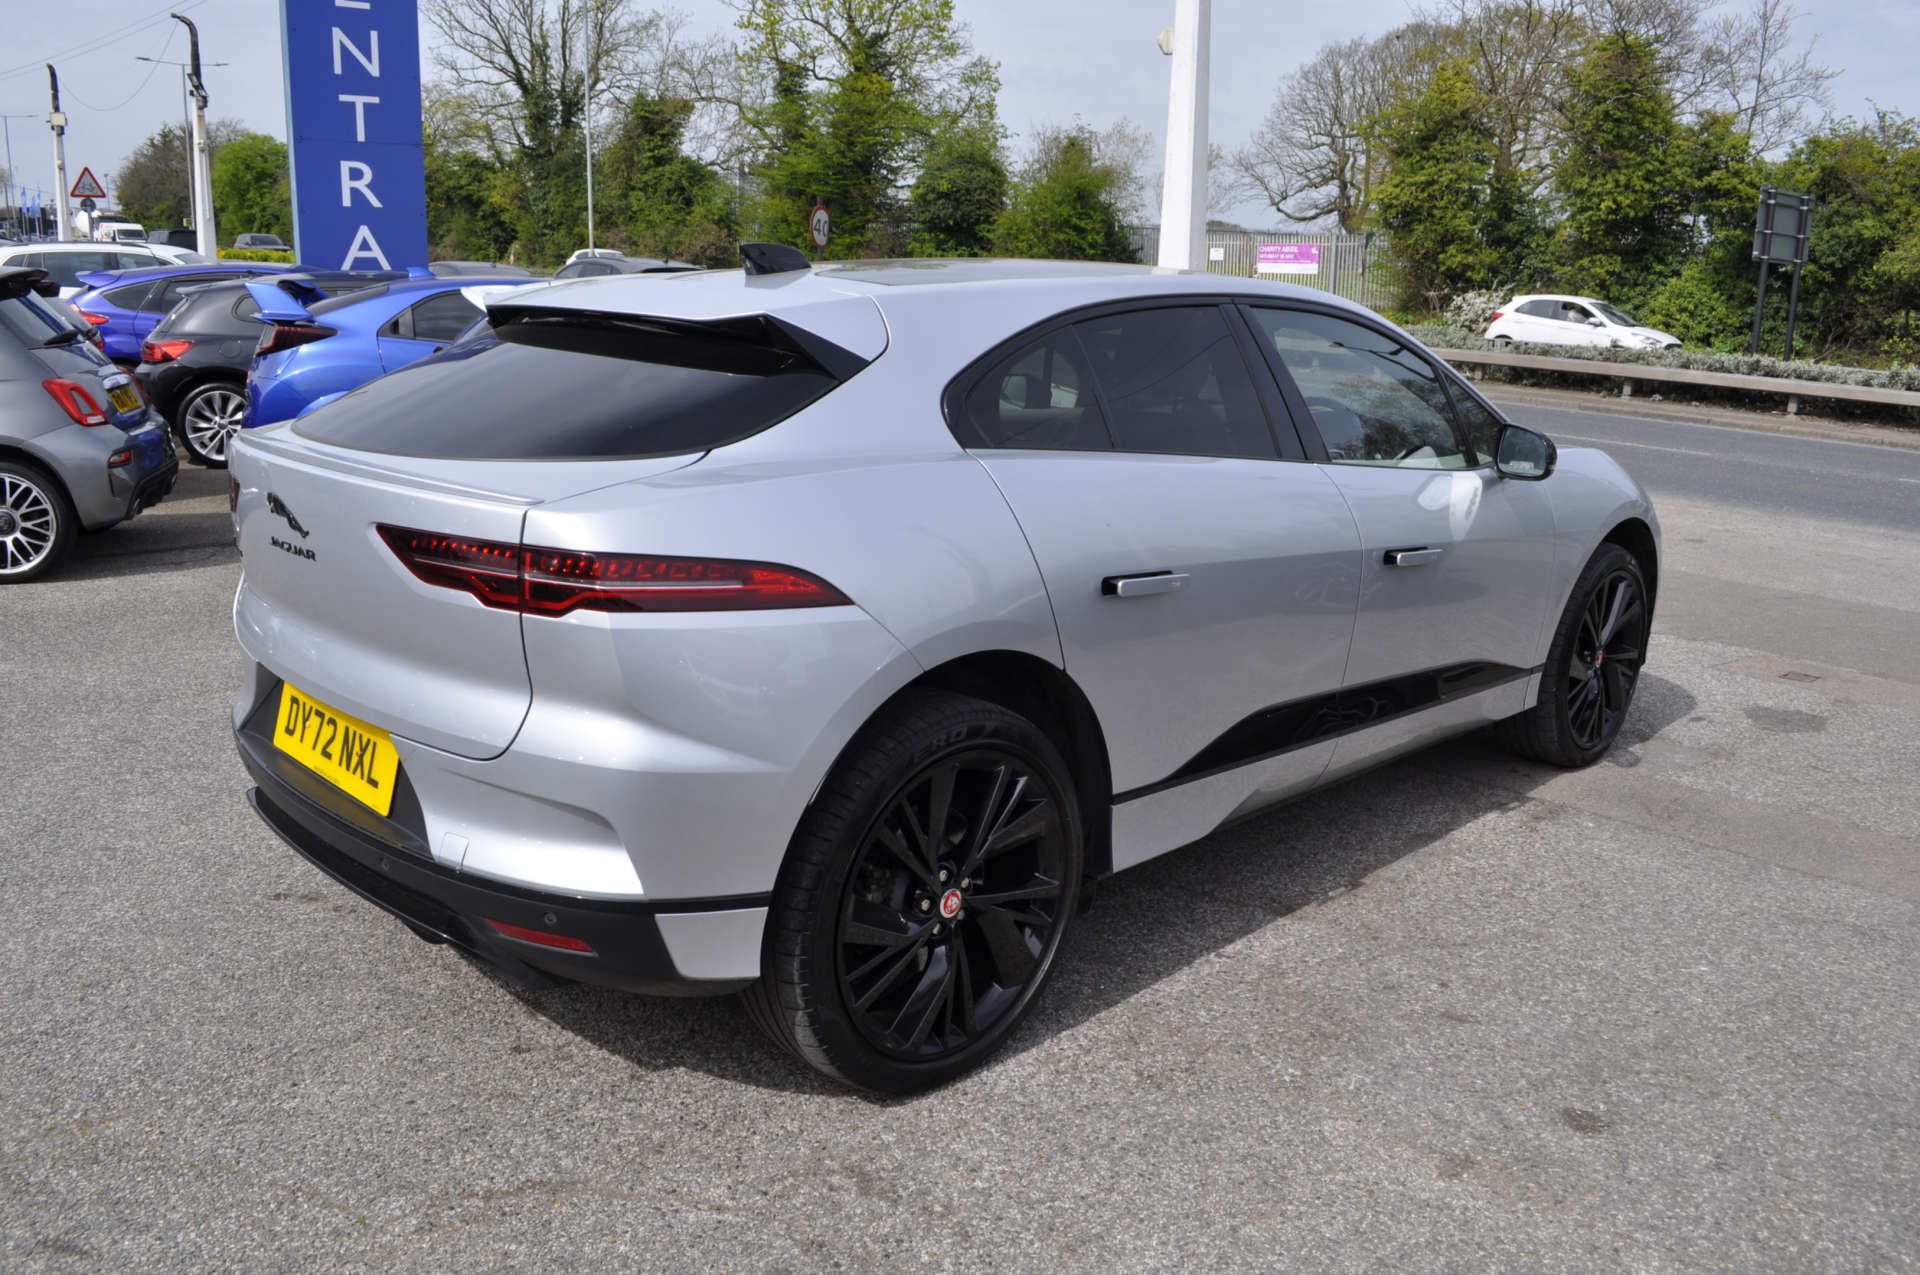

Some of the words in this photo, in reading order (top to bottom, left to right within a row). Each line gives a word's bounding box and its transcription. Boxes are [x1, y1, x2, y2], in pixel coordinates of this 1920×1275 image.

[332, 0, 392, 270] NTRA
[270, 536, 317, 562] JAGUAR
[285, 695, 338, 761] DY72
[338, 726, 379, 790] NXL
